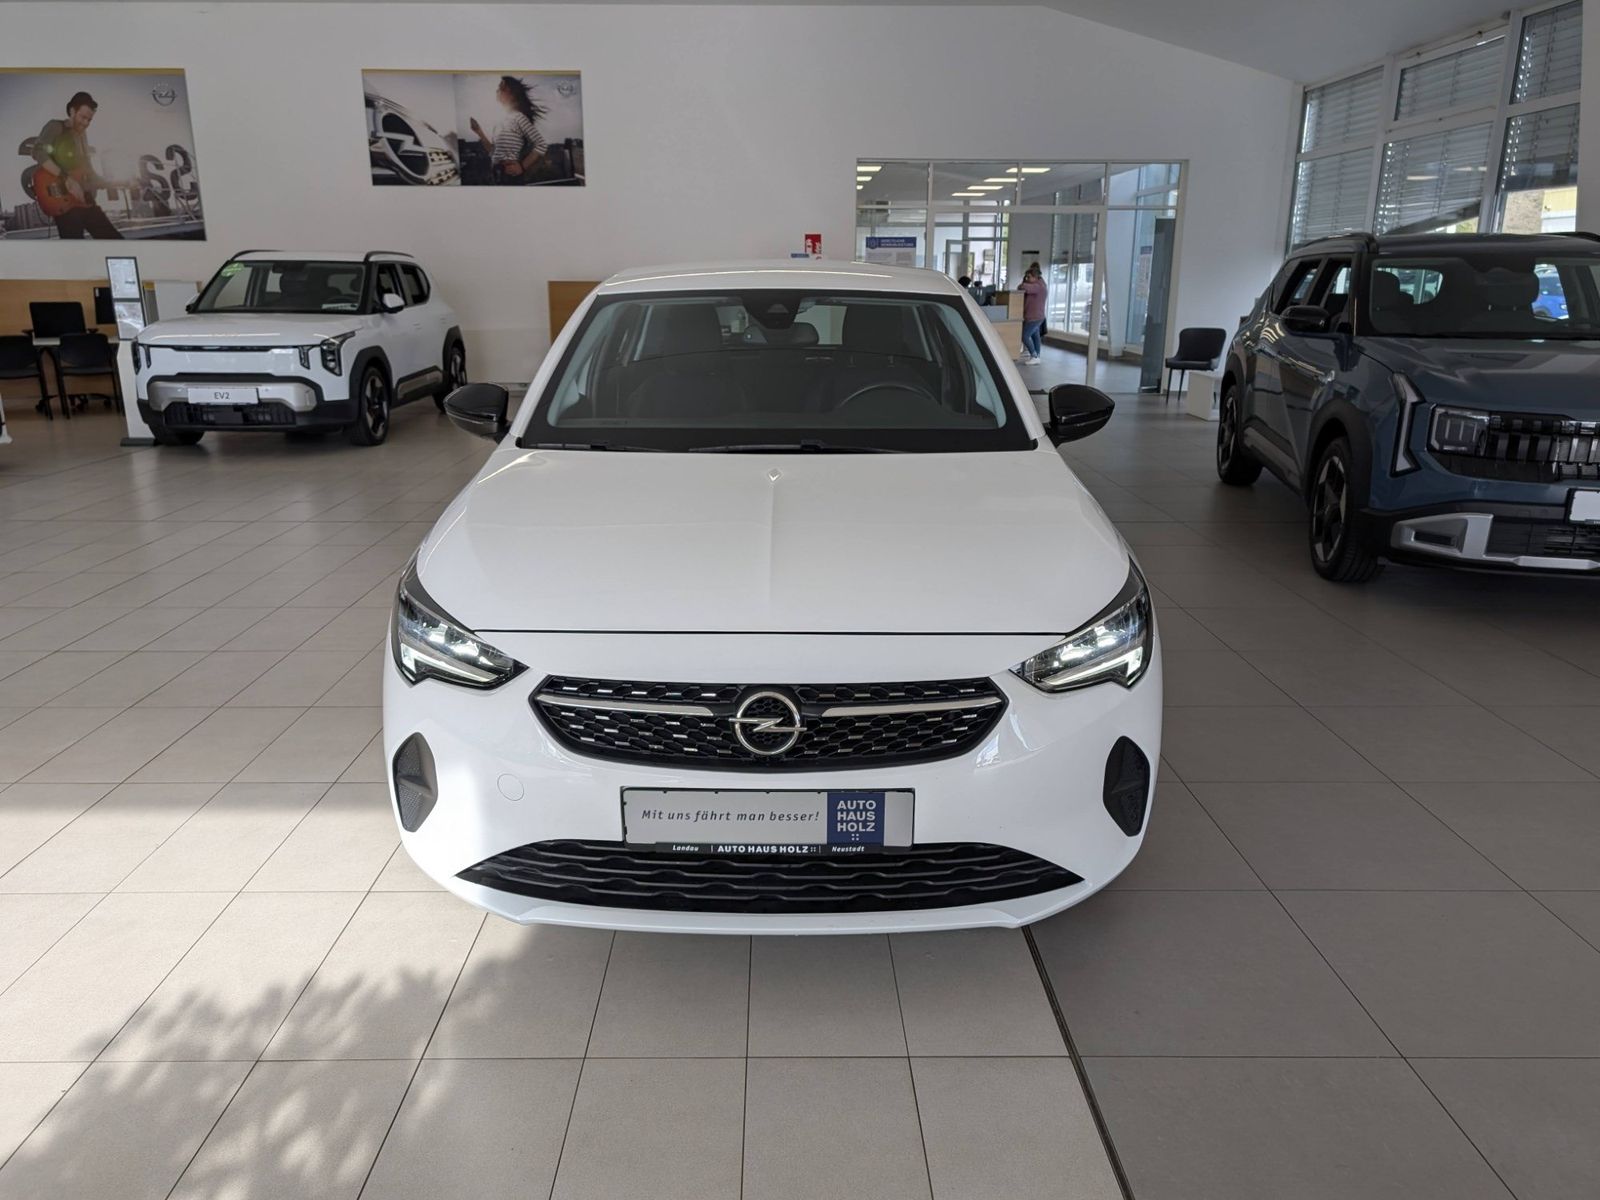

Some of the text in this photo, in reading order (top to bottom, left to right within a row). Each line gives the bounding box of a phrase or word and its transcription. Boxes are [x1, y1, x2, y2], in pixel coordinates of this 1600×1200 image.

[214, 391, 230, 400] EV2
[836, 799, 877, 810] AUTO
[641, 809, 820, 823] Mit uns fährt man besser!
[836, 811, 876, 821] HAUS
[836, 822, 876, 832] HOLZ
[672, 844, 700, 852] Landau
[717, 845, 746, 853] AUTO
[747, 845, 777, 853] HAUS
